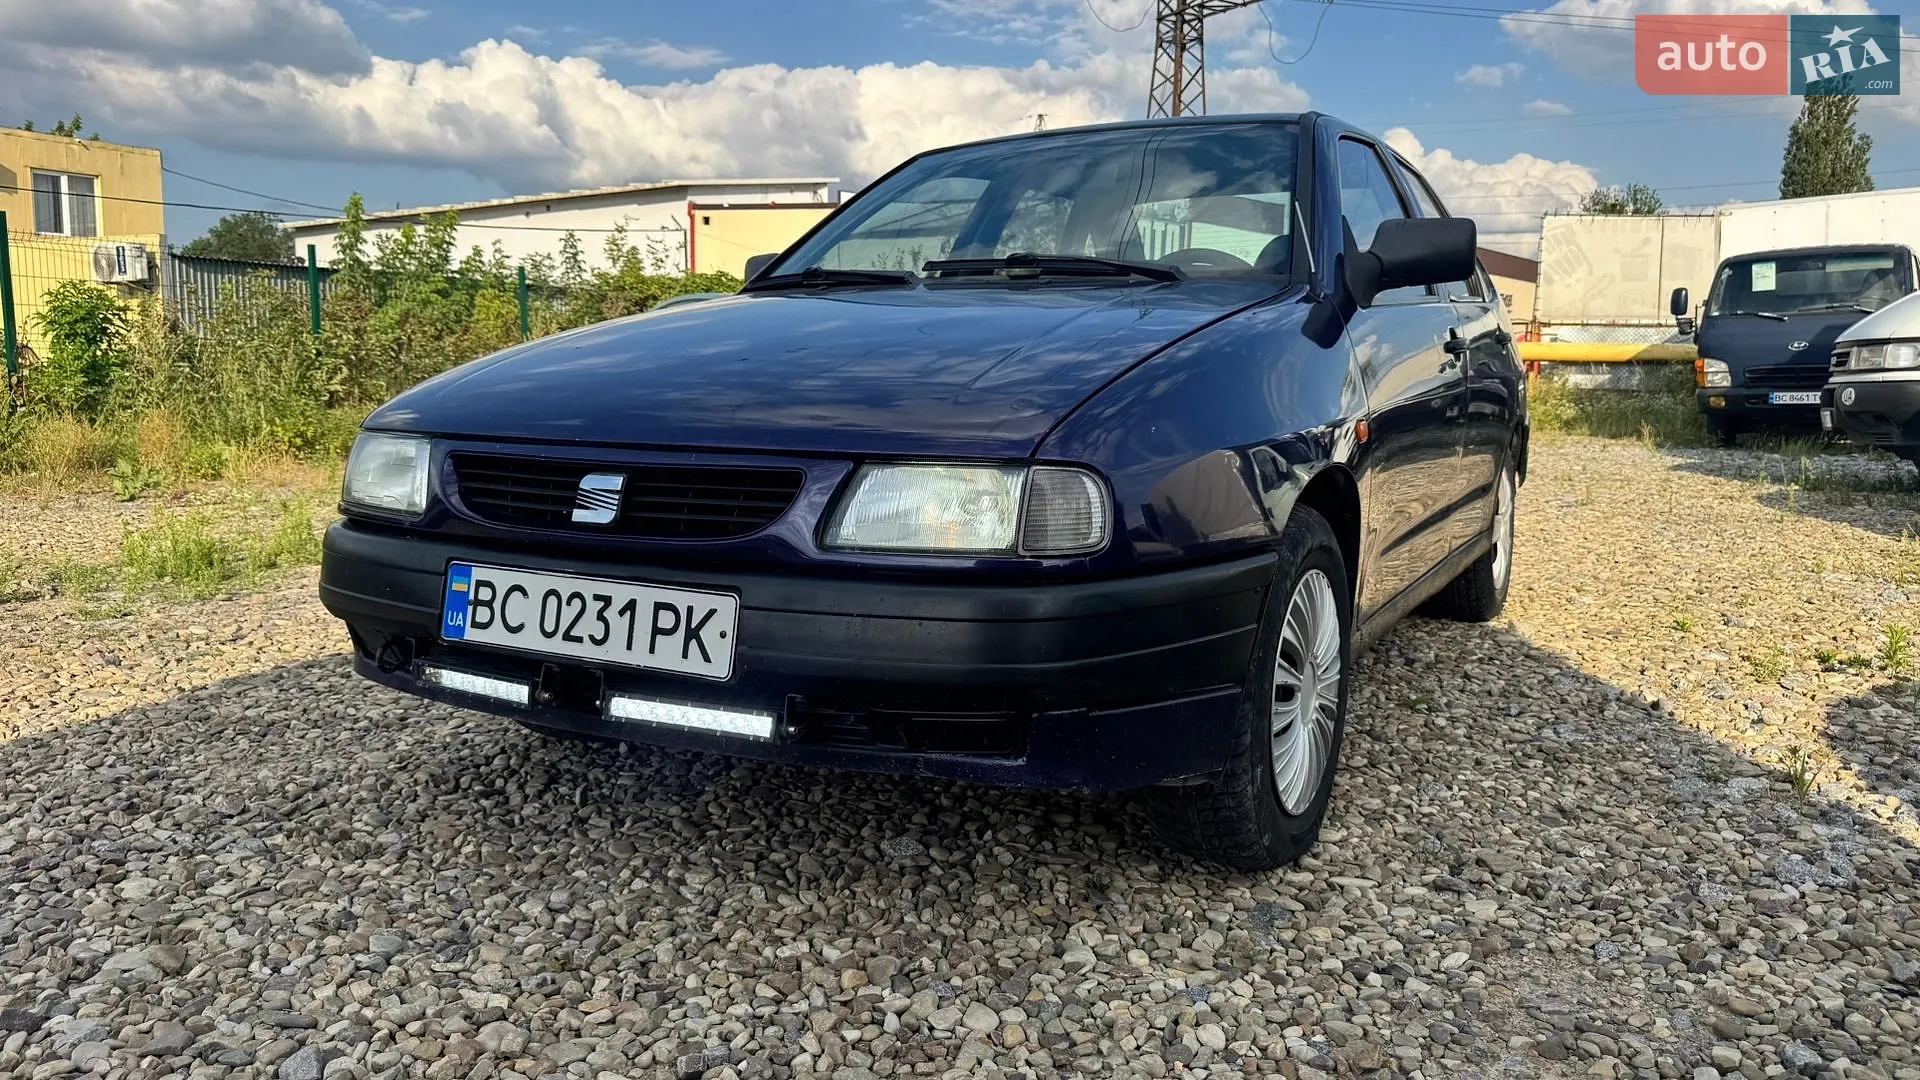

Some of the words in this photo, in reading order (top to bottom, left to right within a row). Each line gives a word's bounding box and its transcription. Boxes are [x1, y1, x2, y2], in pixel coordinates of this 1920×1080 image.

[1774, 393, 1788, 402] BC
[447, 610, 464, 628] UA
[470, 578, 530, 635] BC
[539, 587, 638, 652] 0231
[648, 600, 718, 664] PK
